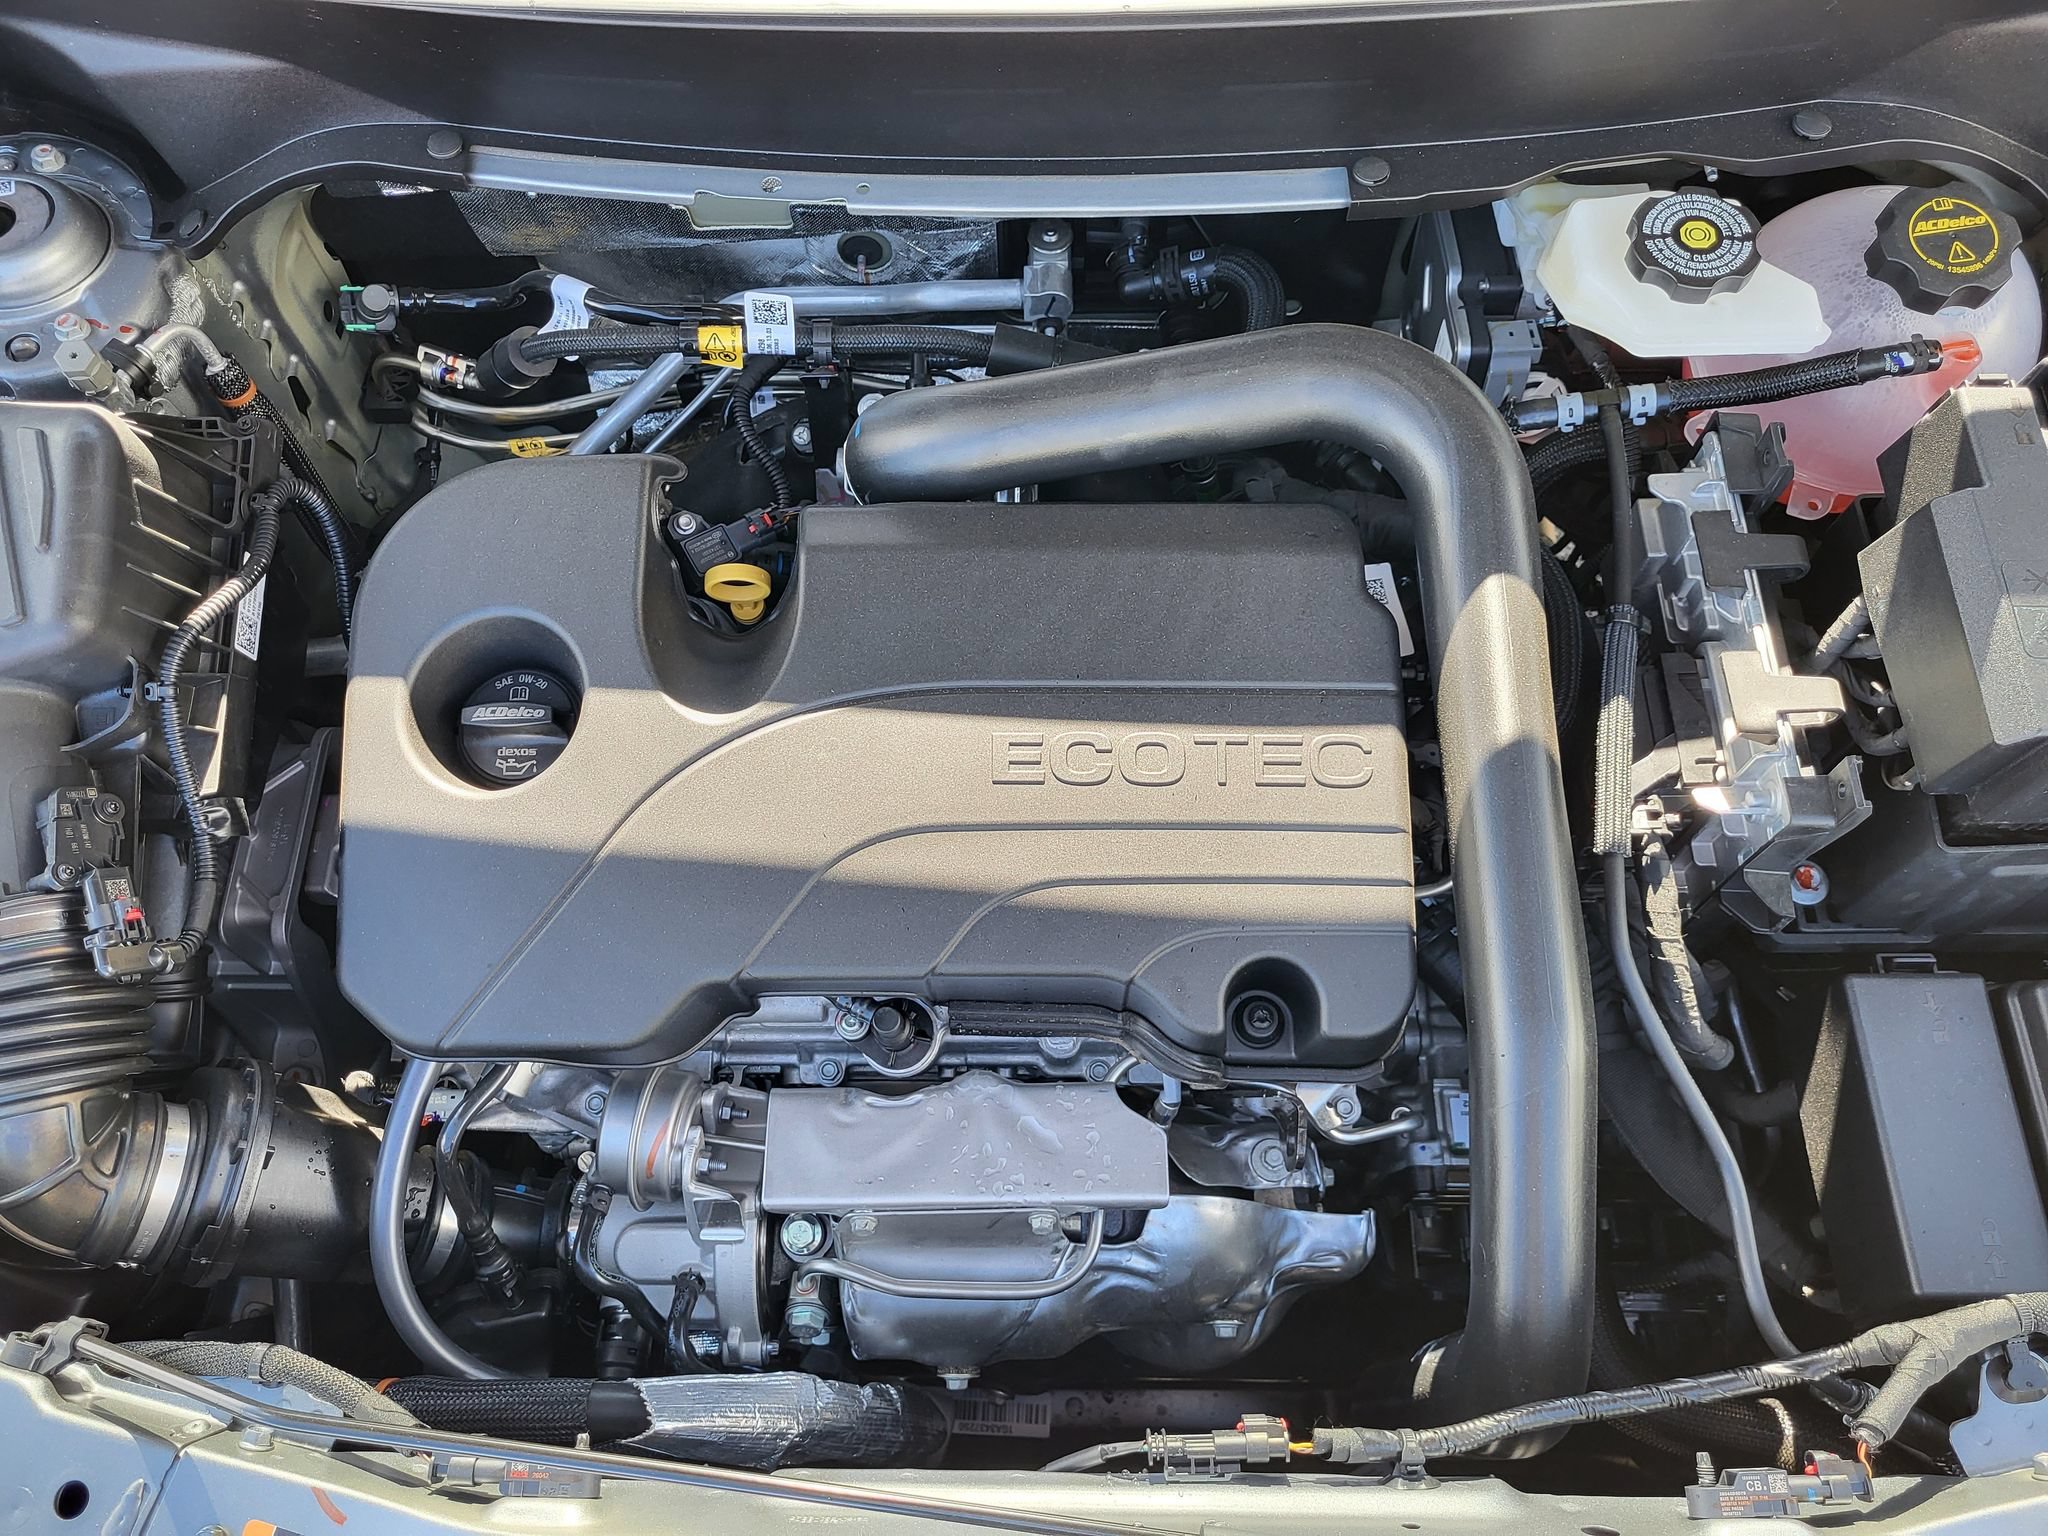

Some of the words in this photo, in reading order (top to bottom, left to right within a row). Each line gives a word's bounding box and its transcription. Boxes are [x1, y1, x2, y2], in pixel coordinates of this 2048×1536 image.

[1668, 203, 1682, 213] QUE
[1680, 201, 1690, 209] DU
[1689, 201, 1714, 211] LIQUIDE
[1711, 206, 1723, 214] DE
[1691, 194, 1723, 205] BOUCHON
[1718, 201, 1740, 216] AVANT
[1699, 210, 1719, 221] BIDON
[1713, 215, 1731, 236] SCELLE
[1915, 215, 1986, 233] ACDelco
[1653, 238, 1667, 251] CAP
[1692, 251, 1717, 261] CLEAN
[1713, 238, 1733, 256] FILLER
[1727, 239, 1743, 255] ONLY
[1653, 253, 1675, 269] FLUID
[1671, 264, 1695, 275] FROM
[1702, 264, 1730, 277] SEALED
[1659, 248, 1688, 266] BEFORE
[1720, 252, 1735, 263] USE
[494, 675, 514, 690] SAE
[518, 674, 548, 690] 0W-20
[471, 706, 545, 718] ACDelco
[497, 746, 538, 756] dexos
[991, 731, 1375, 789] ECOTEC
